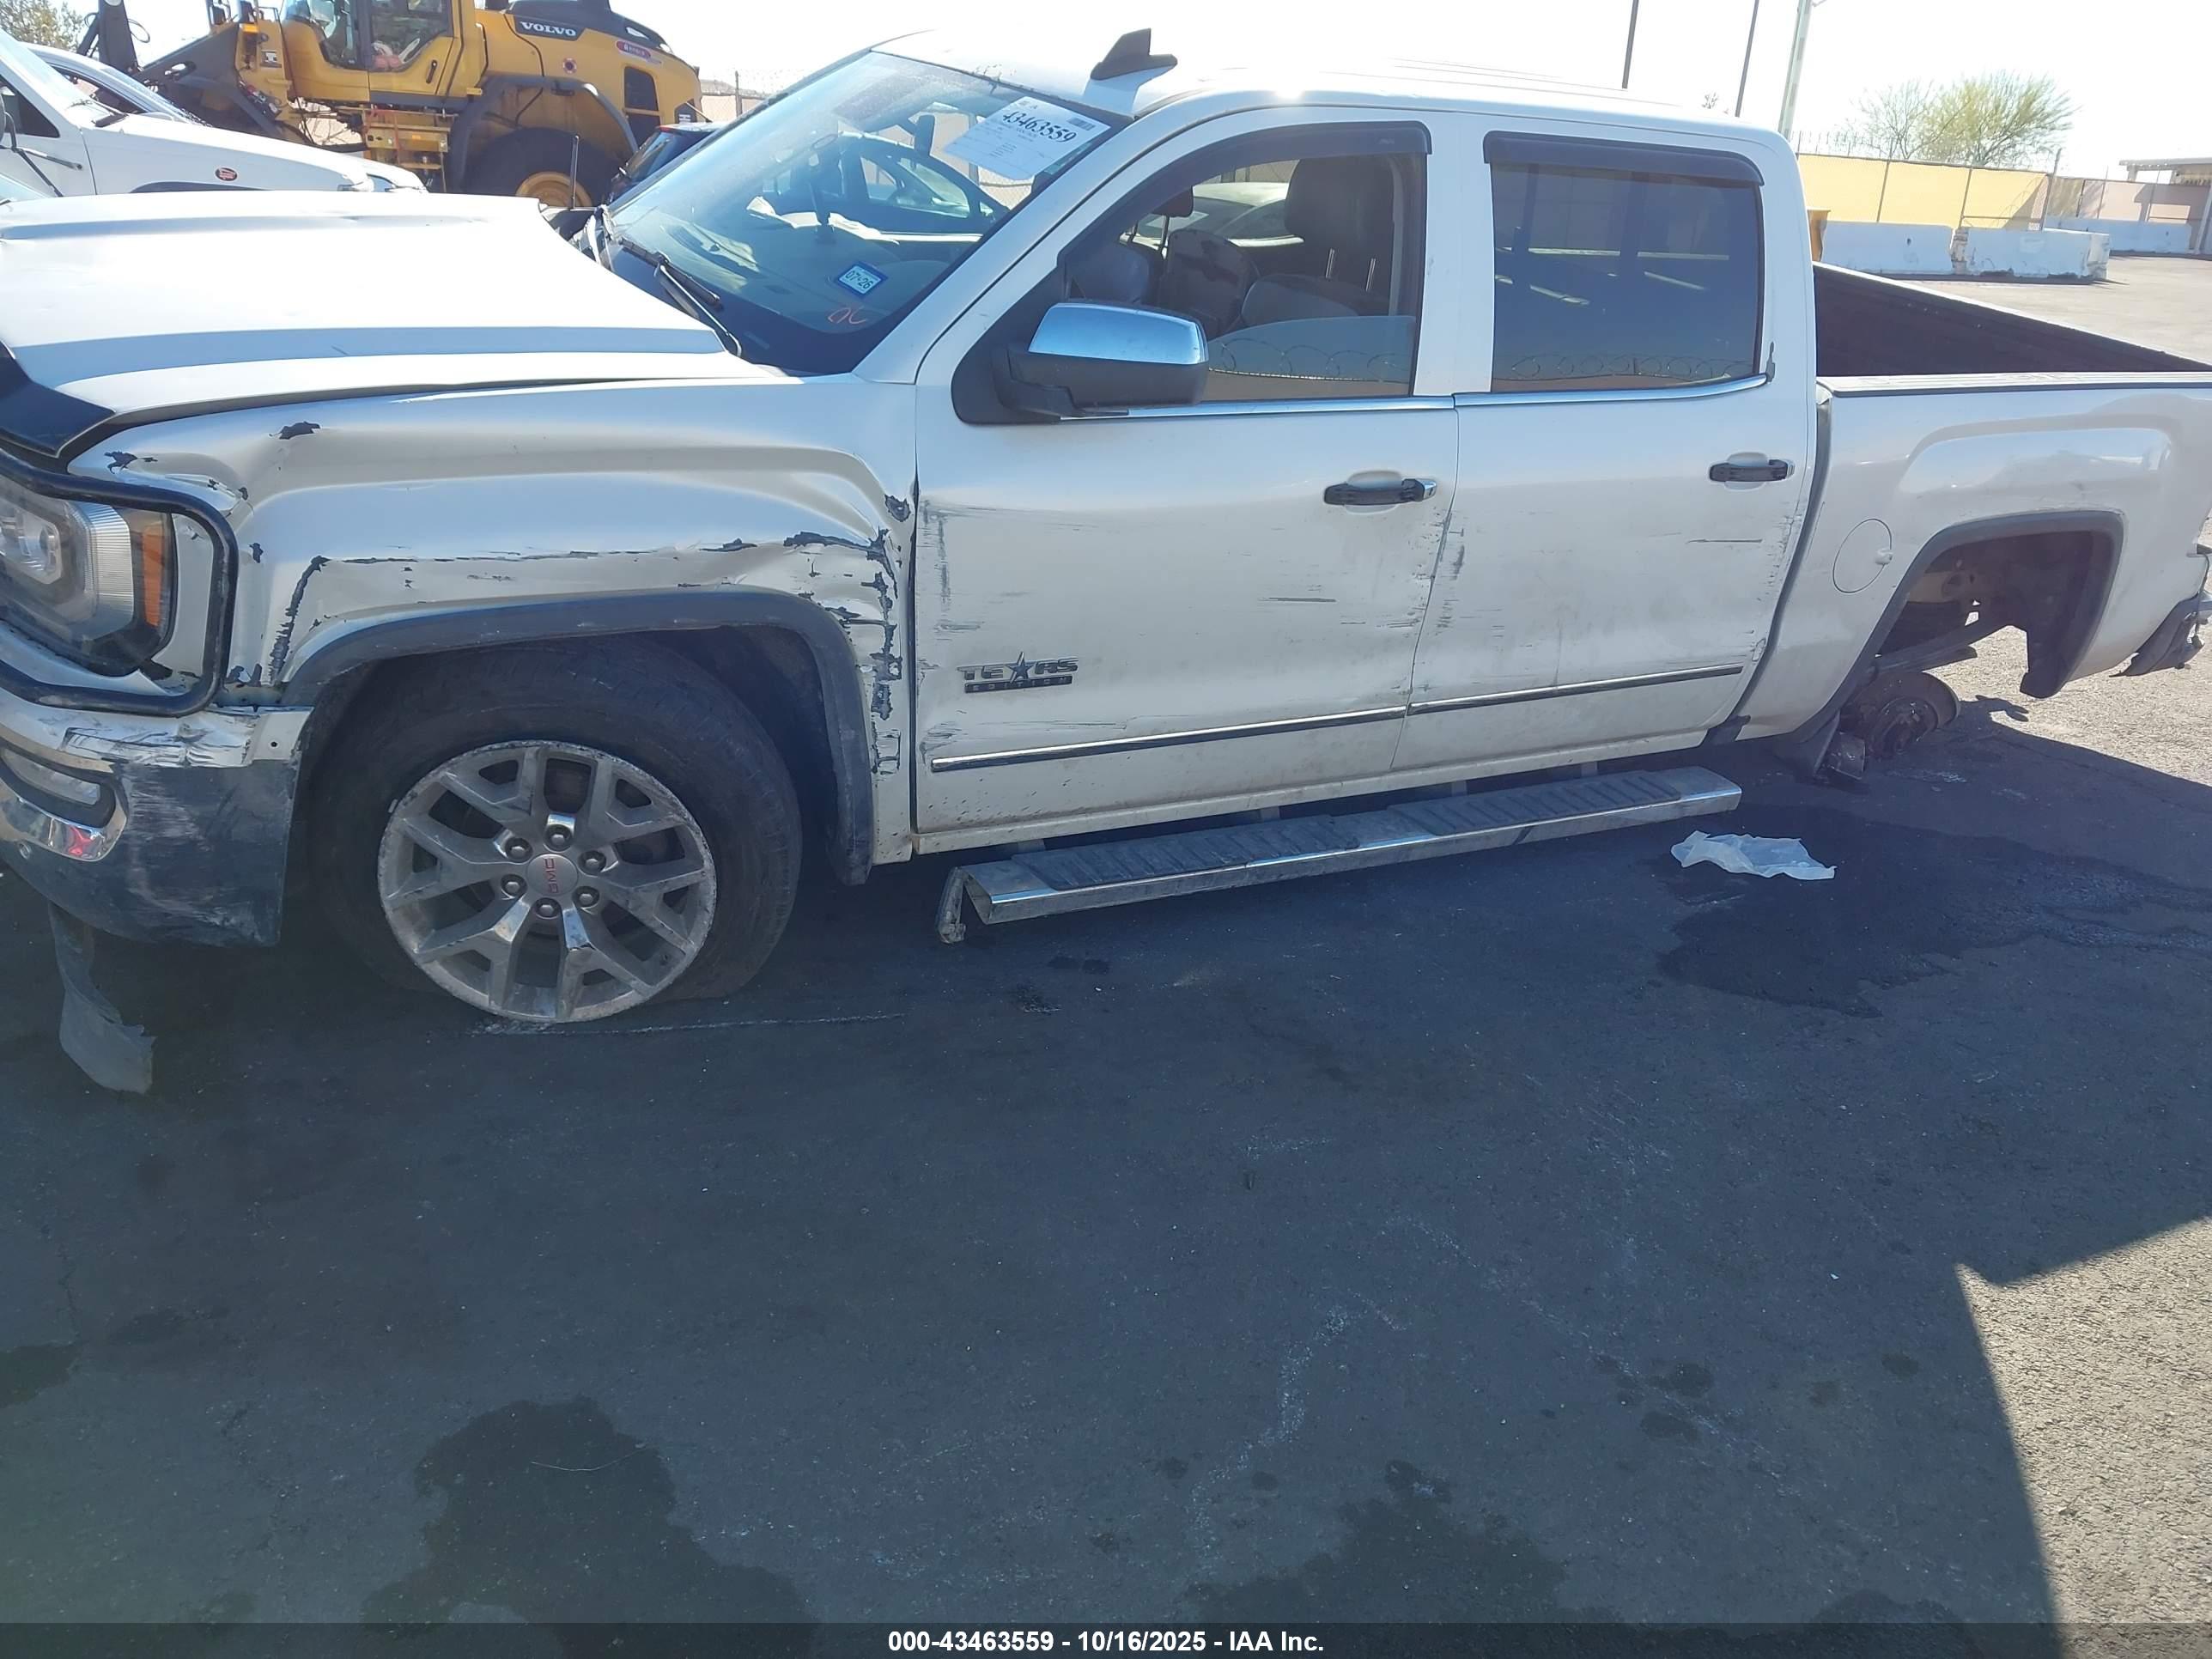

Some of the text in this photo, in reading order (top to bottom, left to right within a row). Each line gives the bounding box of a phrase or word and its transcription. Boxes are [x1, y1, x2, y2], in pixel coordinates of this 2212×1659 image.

[520, 21, 577, 37] VOLVO
[1002, 111, 1078, 143] 43463559
[957, 652, 1079, 684] TEXAS
[544, 858, 559, 894] GMC
